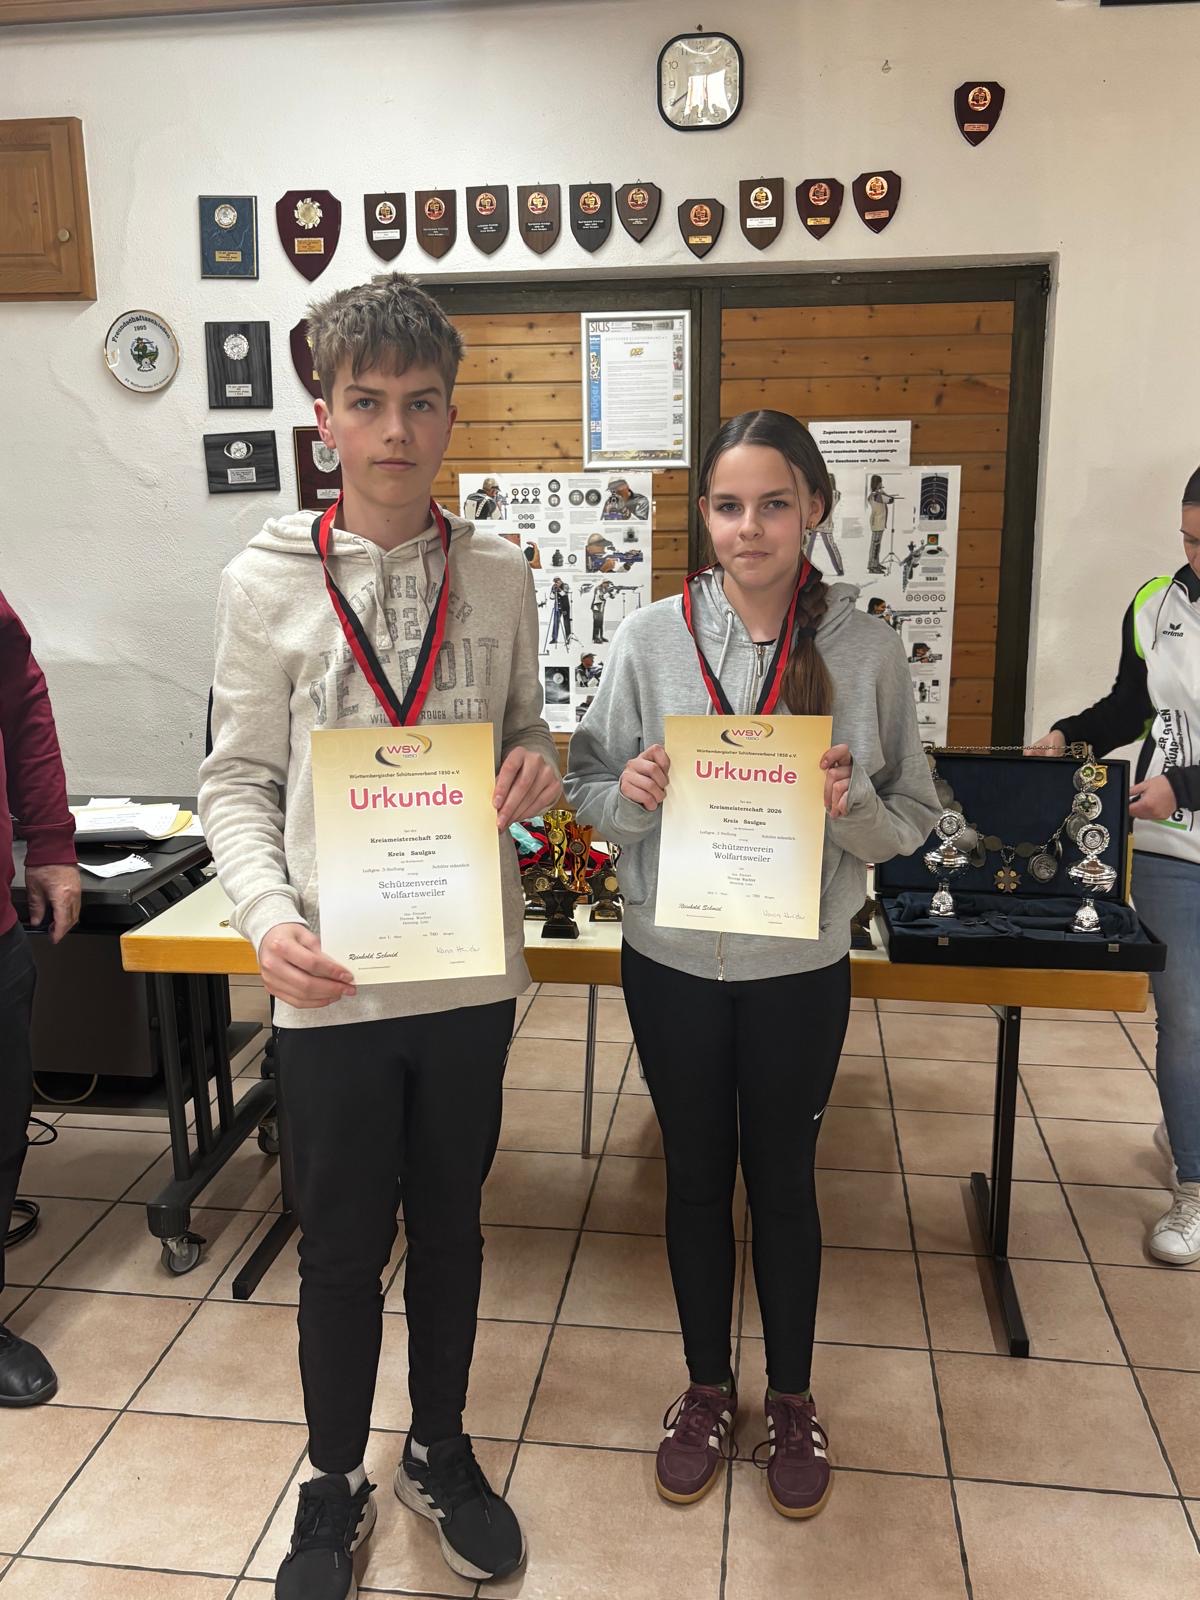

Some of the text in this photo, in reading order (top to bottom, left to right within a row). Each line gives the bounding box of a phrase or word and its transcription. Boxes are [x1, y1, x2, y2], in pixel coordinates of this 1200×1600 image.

[668, 60, 679, 70] 10
[668, 80, 676, 89] 9
[1162, 630, 1184, 638] erima
[731, 729, 763, 737] WSV
[386, 744, 421, 754] WSV
[695, 760, 798, 785] Urkunde
[349, 783, 464, 810] Urkunde
[709, 803, 764, 813] Kreismeisterschaft
[743, 819, 767, 827] Saulgau
[370, 835, 431, 844] Kreismeisterschaft
[410, 849, 437, 857] Saulgau
[711, 842, 774, 854] Schützenverein
[714, 851, 772, 863] Wolfartsweiler
[378, 877, 448, 889] Schützenverein
[381, 888, 446, 900] Wolfartsweiler
